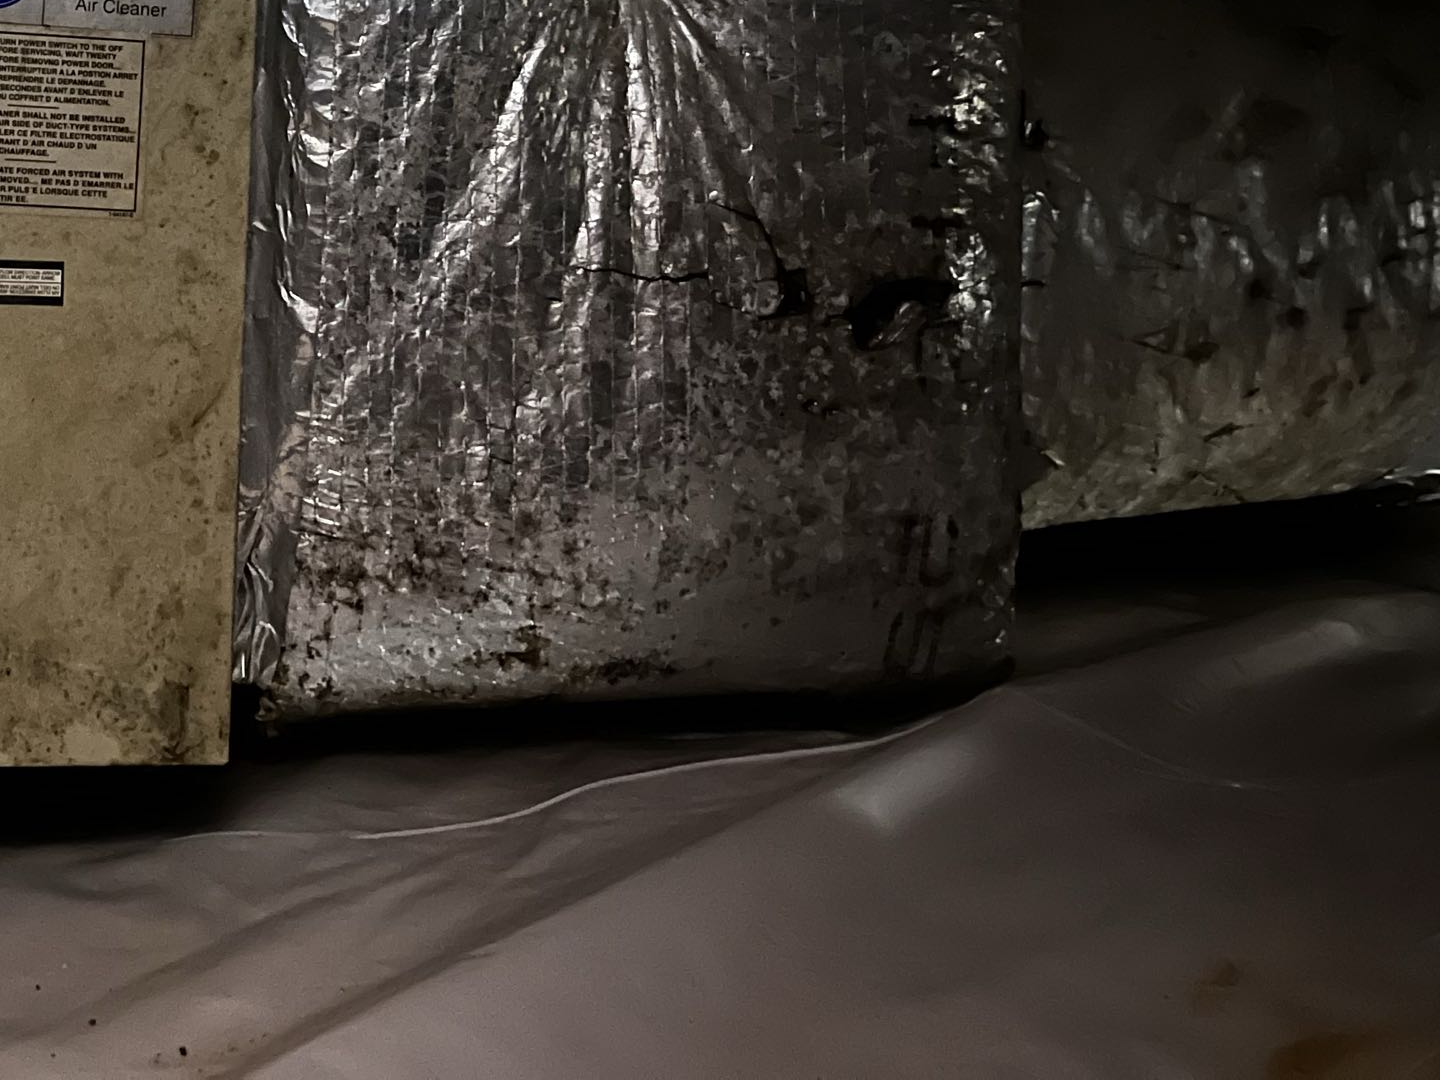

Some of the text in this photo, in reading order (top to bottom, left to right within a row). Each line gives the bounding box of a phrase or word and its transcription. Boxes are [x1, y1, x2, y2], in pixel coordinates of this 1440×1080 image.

[102, 0, 167, 17] Cleaner
[86, 51, 117, 59] TWENTY
[62, 59, 90, 67] POWER
[0, 84, 42, 92] SECONDES
[82, 115, 126, 123] INSTALLED
[30, 130, 58, 138] FILTRE
[60, 132, 135, 142] ELECTROSTATIQUE
[16, 168, 50, 176] FORCED
[40, 188, 79, 196] LORSQUE
[81, 190, 108, 198] CETTE
